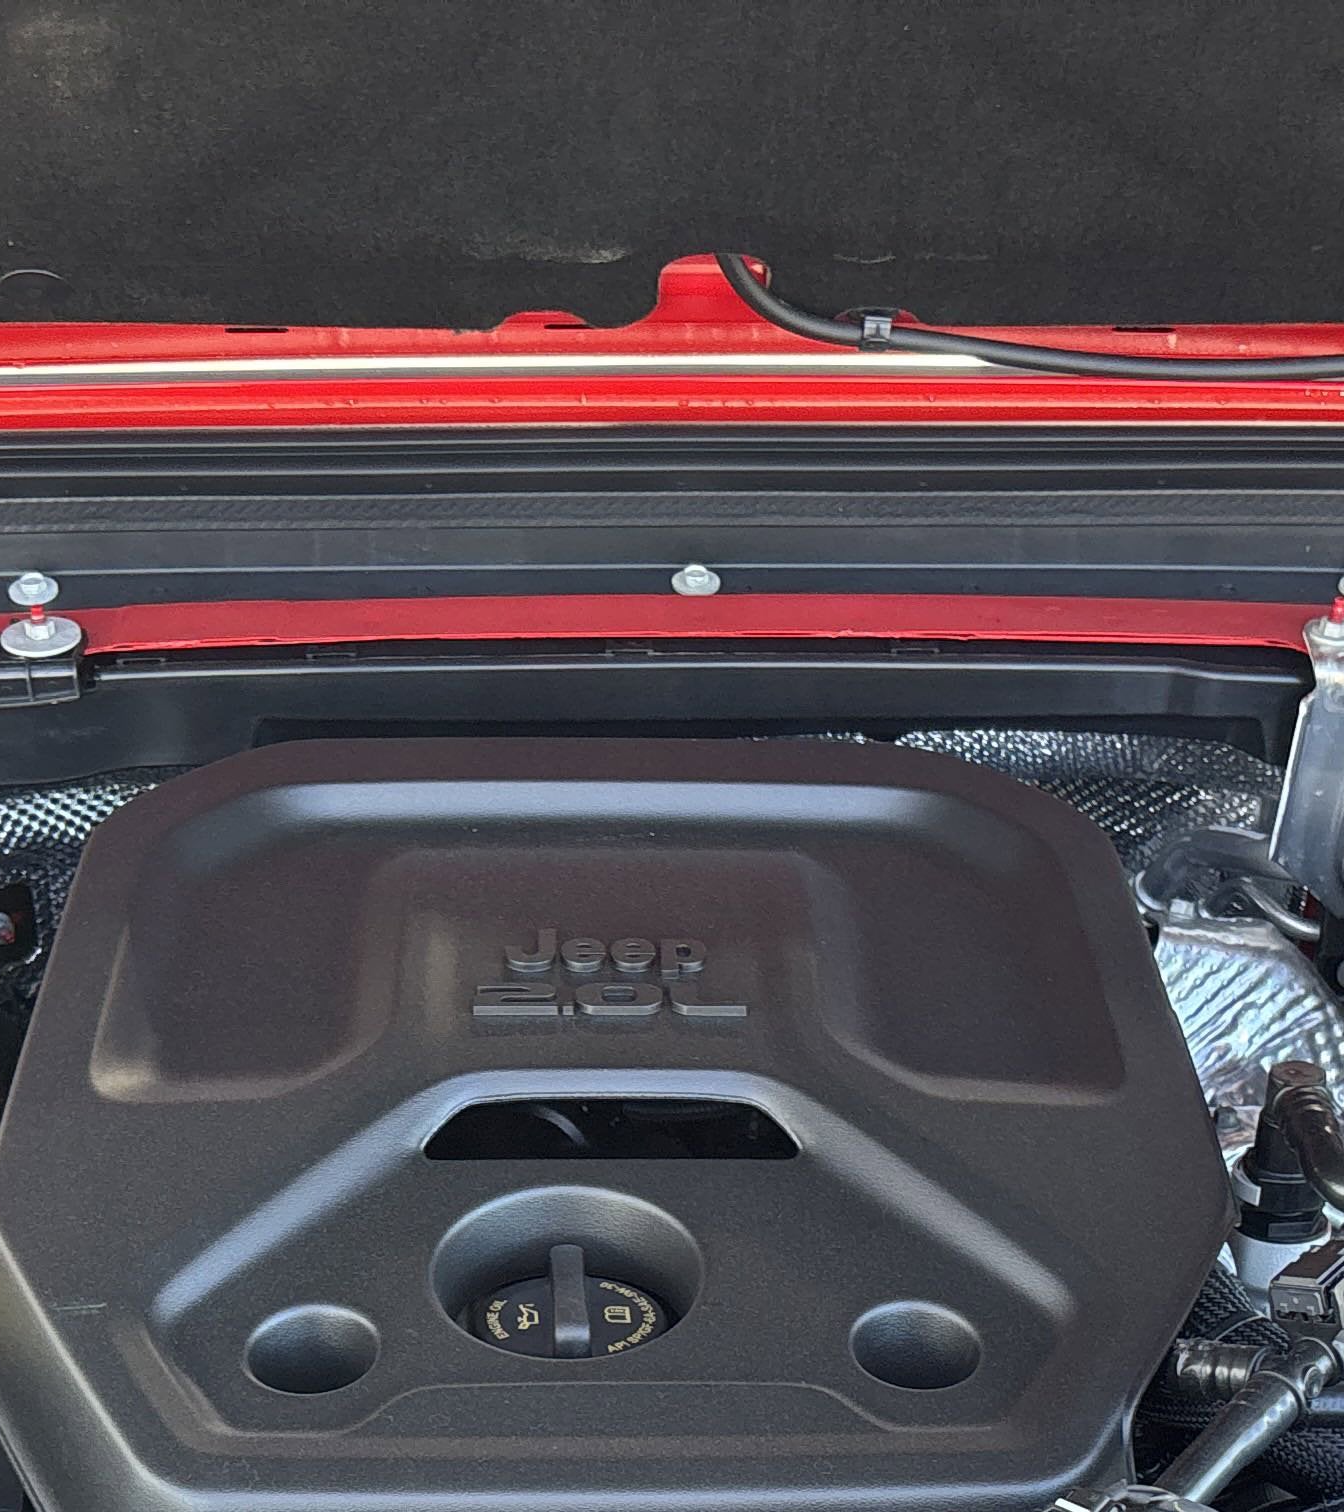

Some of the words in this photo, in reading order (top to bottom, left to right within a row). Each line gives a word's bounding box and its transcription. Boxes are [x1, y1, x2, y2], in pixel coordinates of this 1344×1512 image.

[505, 928, 706, 980] Jeep
[490, 1300, 508, 1311] OIL
[486, 1311, 510, 1340] ENGINE
[607, 1339, 630, 1354] API
